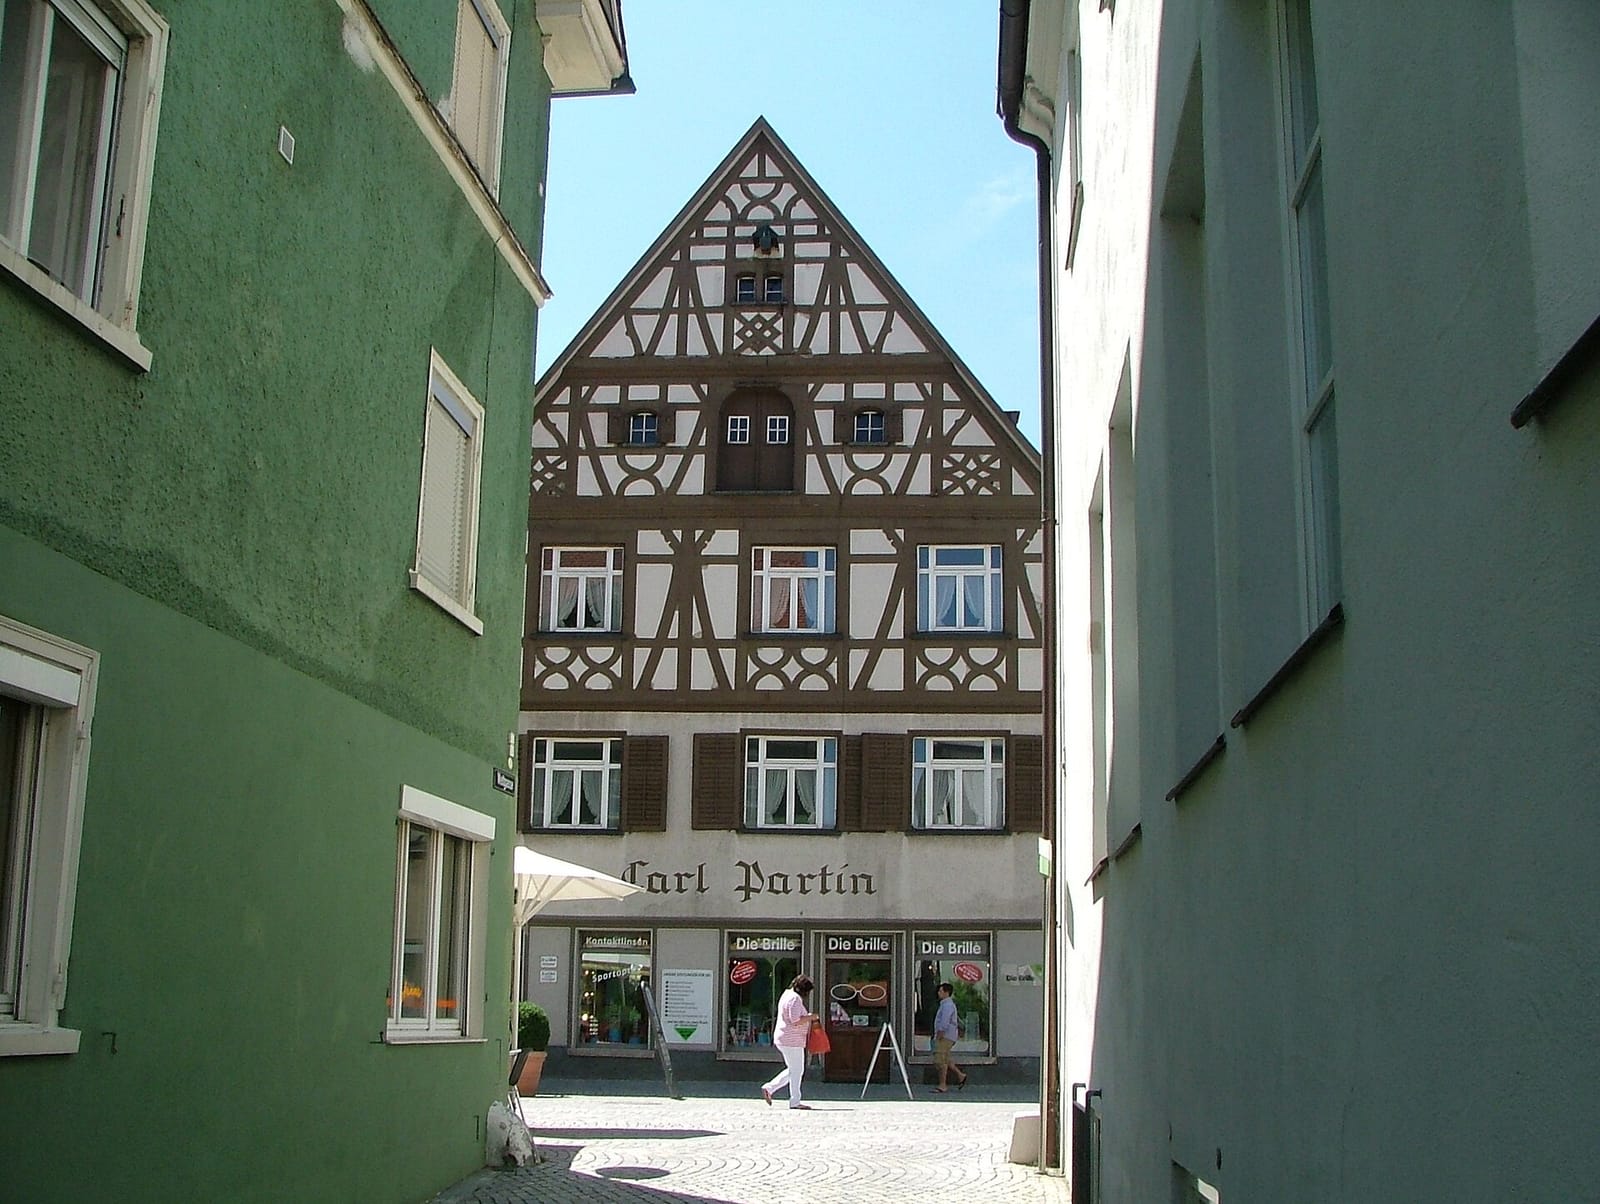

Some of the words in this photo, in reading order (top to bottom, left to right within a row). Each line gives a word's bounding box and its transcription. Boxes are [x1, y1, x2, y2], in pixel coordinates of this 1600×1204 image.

[621, 860, 710, 894] Carl
[734, 860, 877, 902] Partin
[585, 936, 648, 946] Kontaktlinsen
[736, 937, 758, 950] Die
[762, 937, 795, 950] Brille
[828, 937, 851, 951] Die
[855, 937, 889, 951] Brille
[922, 941, 944, 954] Die
[948, 941, 981, 954] Brille
